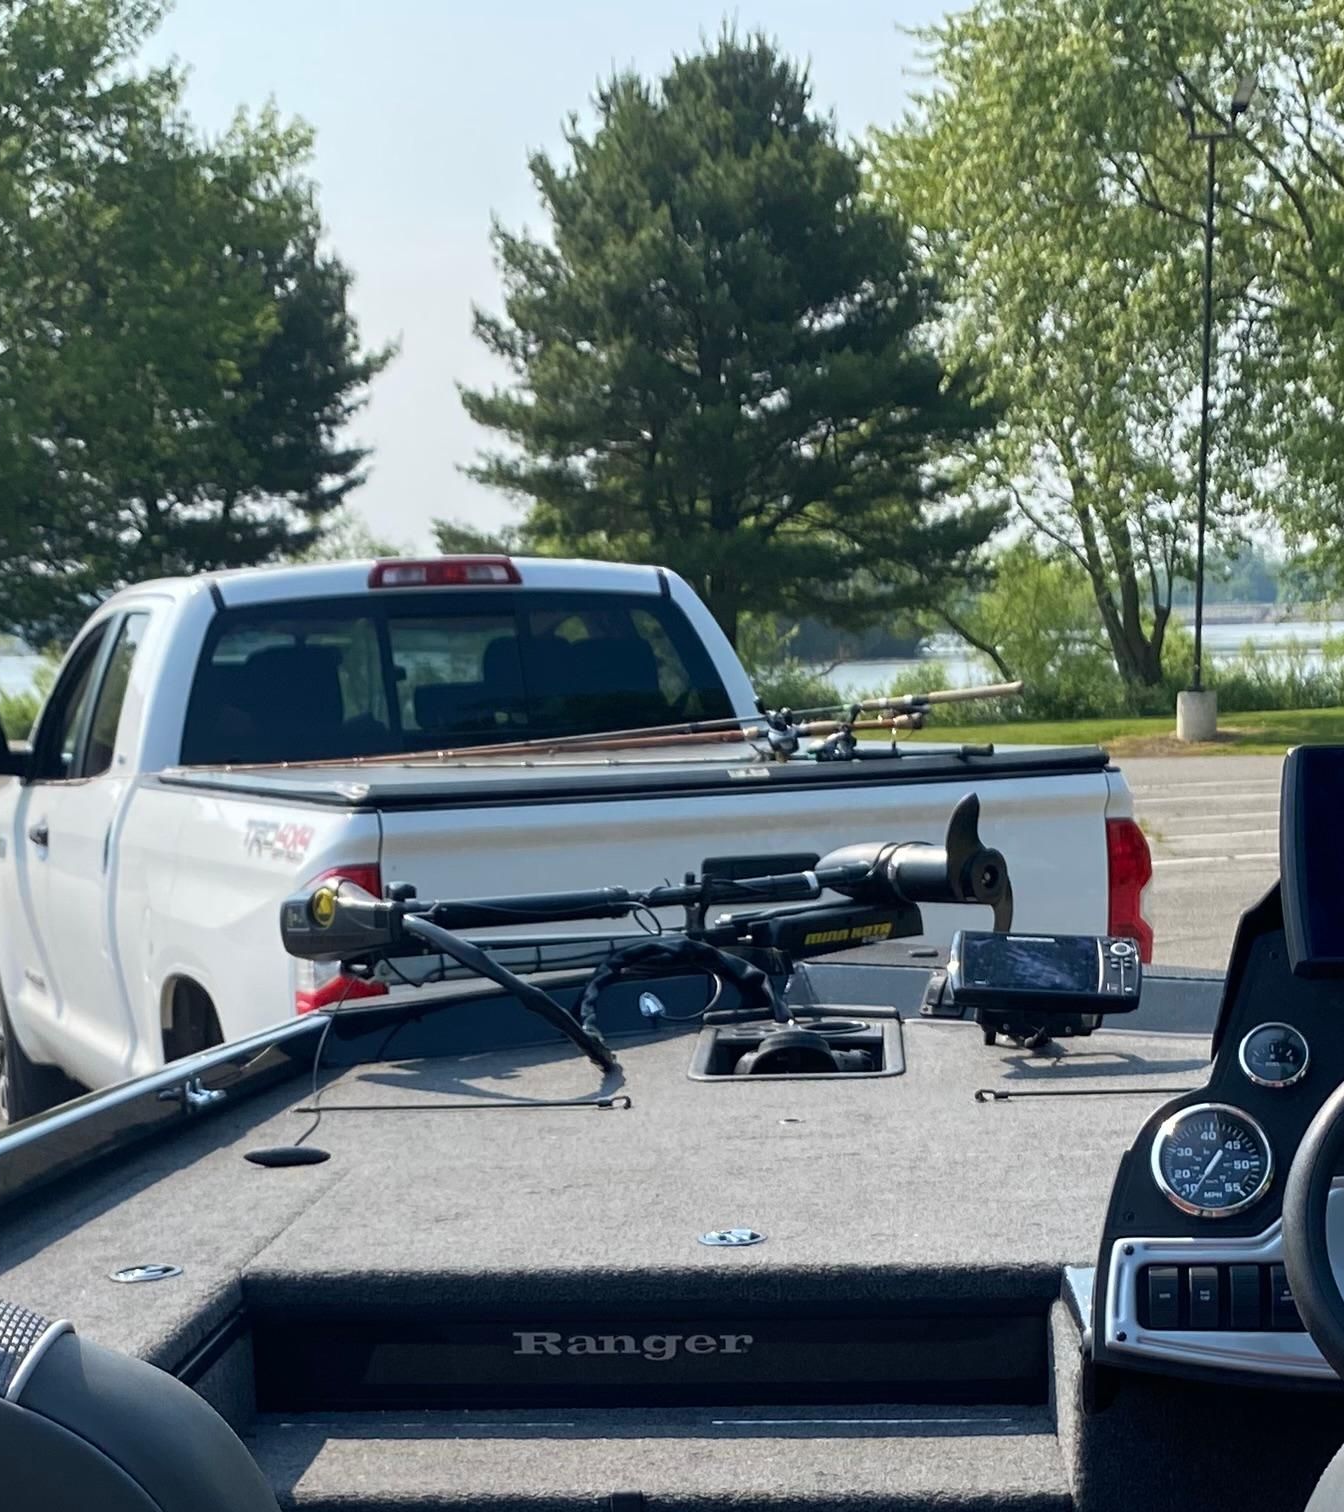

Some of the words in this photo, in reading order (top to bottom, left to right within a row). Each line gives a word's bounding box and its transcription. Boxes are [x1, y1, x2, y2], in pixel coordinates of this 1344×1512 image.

[1200, 1131, 1216, 1140] 40
[1224, 1141, 1241, 1150] 45
[1176, 1147, 1193, 1156] 30
[1233, 1160, 1250, 1169] 50
[1174, 1169, 1190, 1178] 20
[1224, 1183, 1240, 1192] 55
[512, 1331, 754, 1361] Ranger
